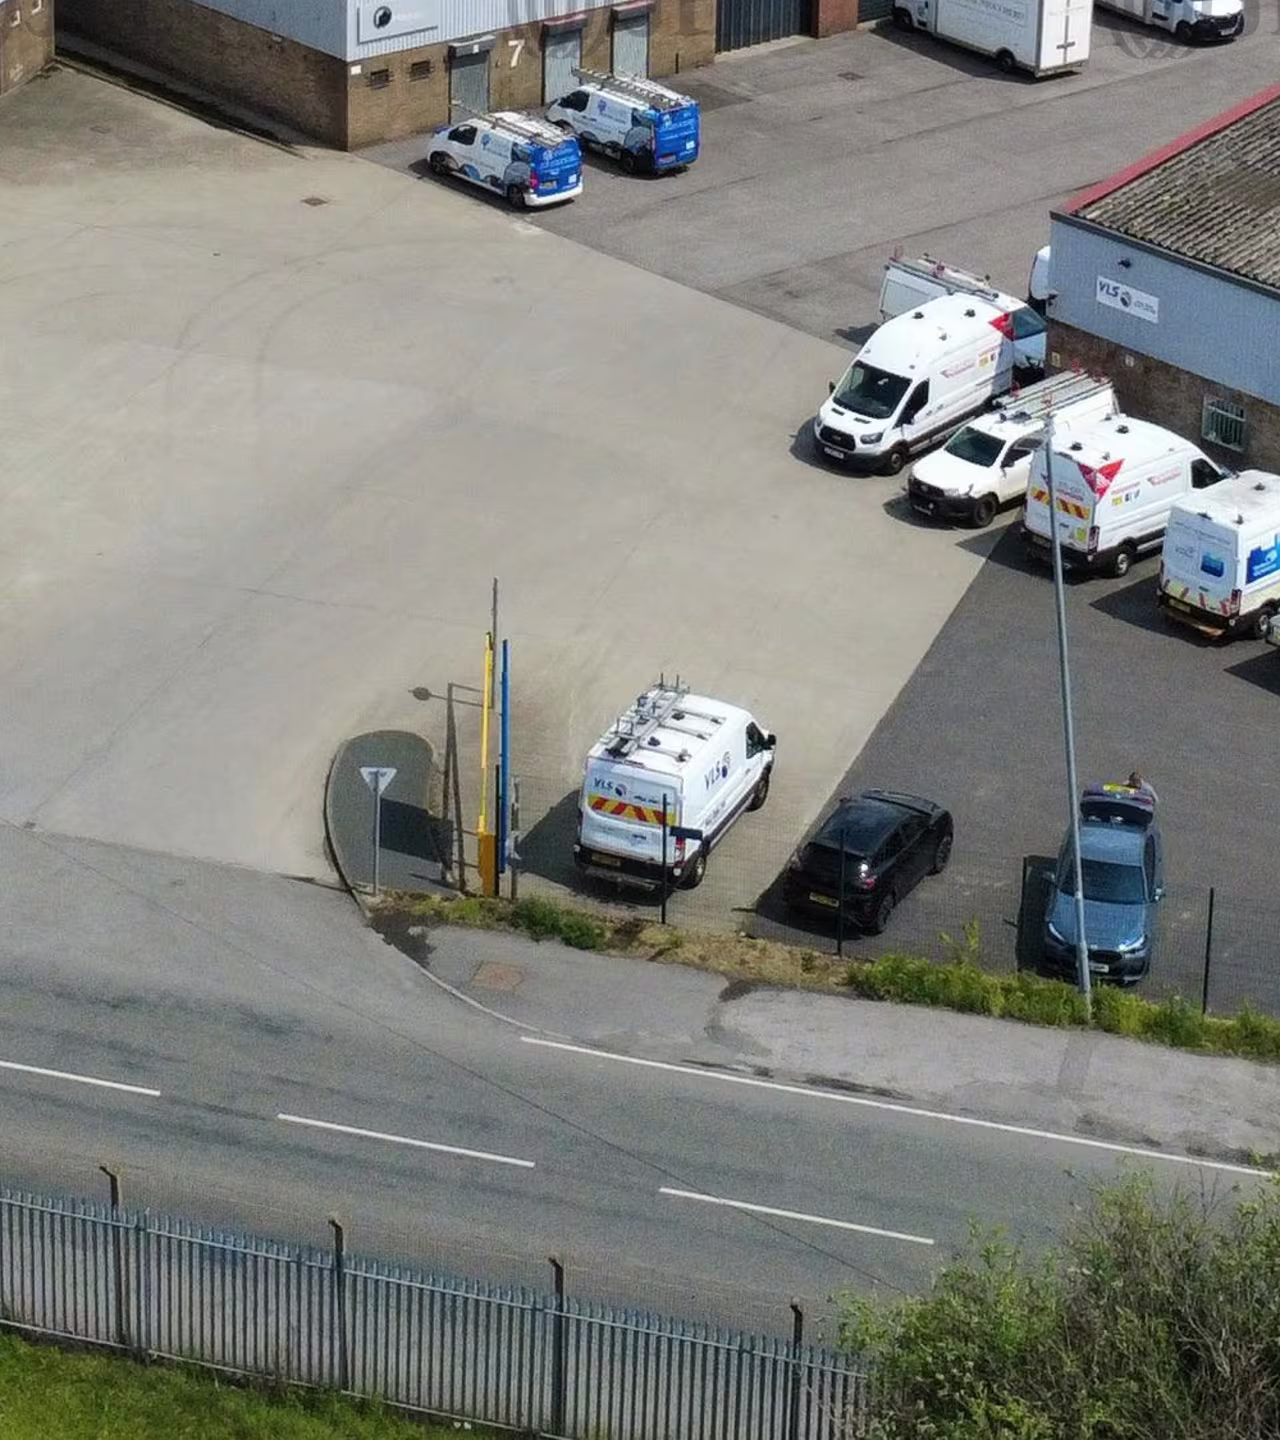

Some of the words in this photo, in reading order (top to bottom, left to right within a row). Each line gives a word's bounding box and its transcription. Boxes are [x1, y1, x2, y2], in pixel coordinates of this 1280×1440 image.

[508, 39, 525, 68] 7
[1099, 281, 1119, 297] VLS
[593, 777, 614, 790] VLS
[704, 762, 720, 790] VLS
